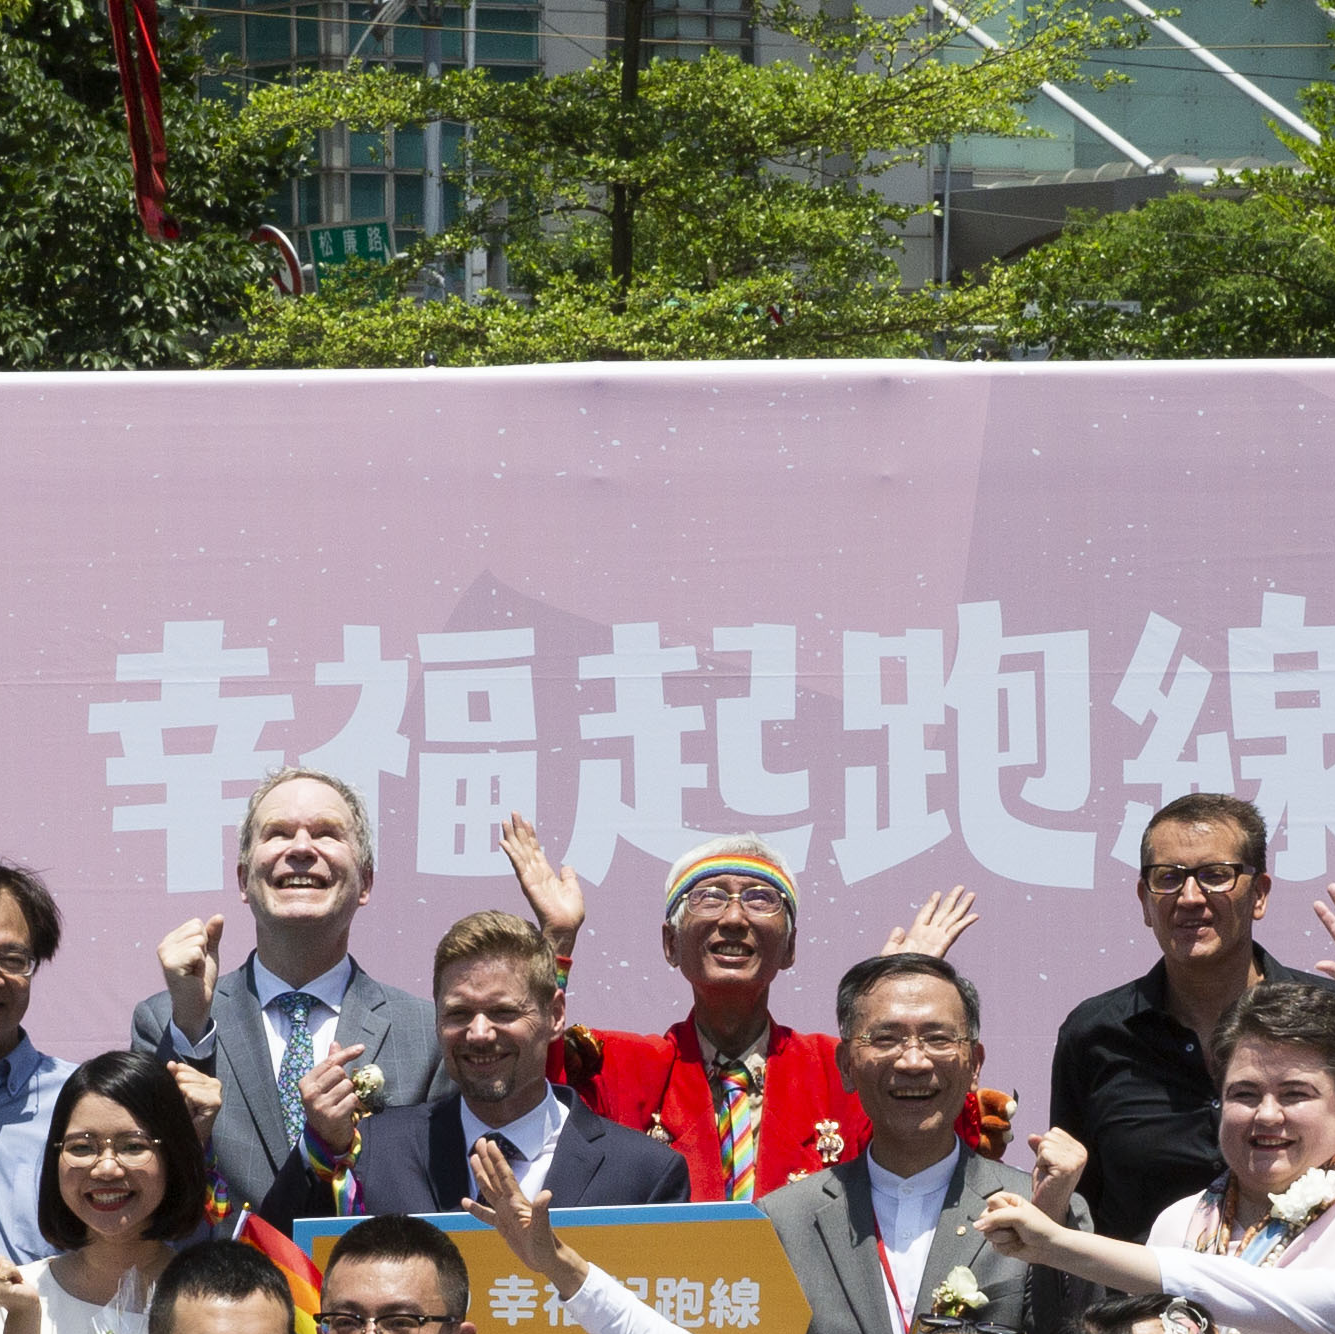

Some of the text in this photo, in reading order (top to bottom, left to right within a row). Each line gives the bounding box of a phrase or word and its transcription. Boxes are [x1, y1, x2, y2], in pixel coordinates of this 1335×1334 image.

[318, 226, 383, 257] 松廉路
[488, 1274, 761, 1329] 幸跑線
